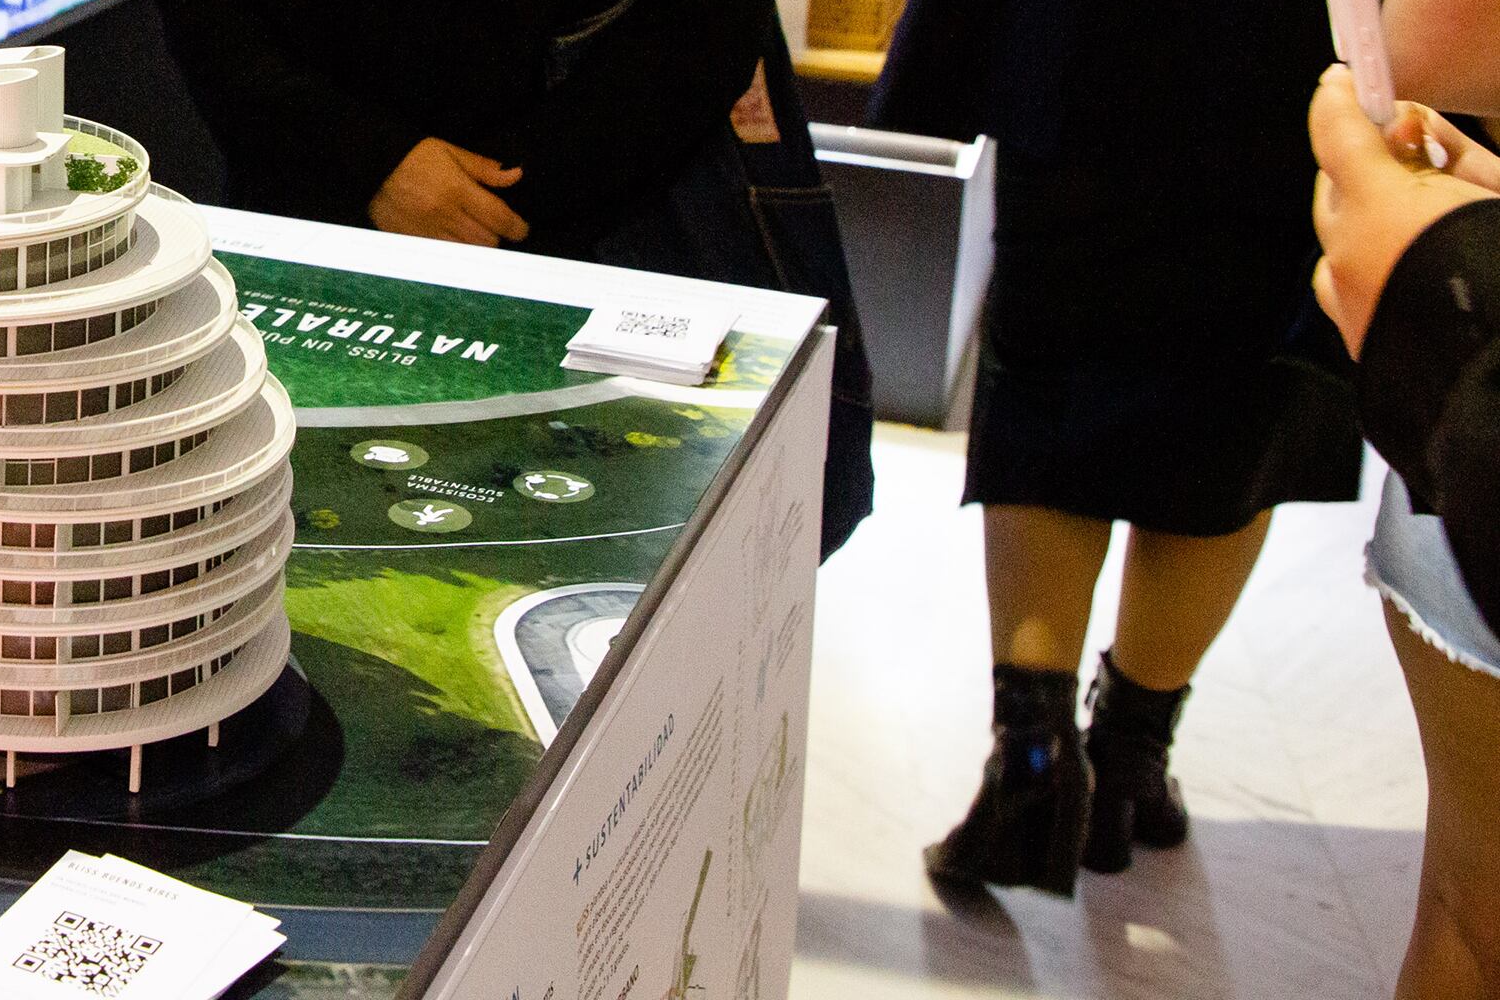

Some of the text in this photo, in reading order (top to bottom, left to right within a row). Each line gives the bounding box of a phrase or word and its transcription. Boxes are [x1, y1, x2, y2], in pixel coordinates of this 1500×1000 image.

[301, 338, 334, 352] UN
[345, 344, 418, 366] BLISS,
[406, 481, 495, 503] ECOSISTEMA
[407, 474, 505, 498] SUSTENTABLE
